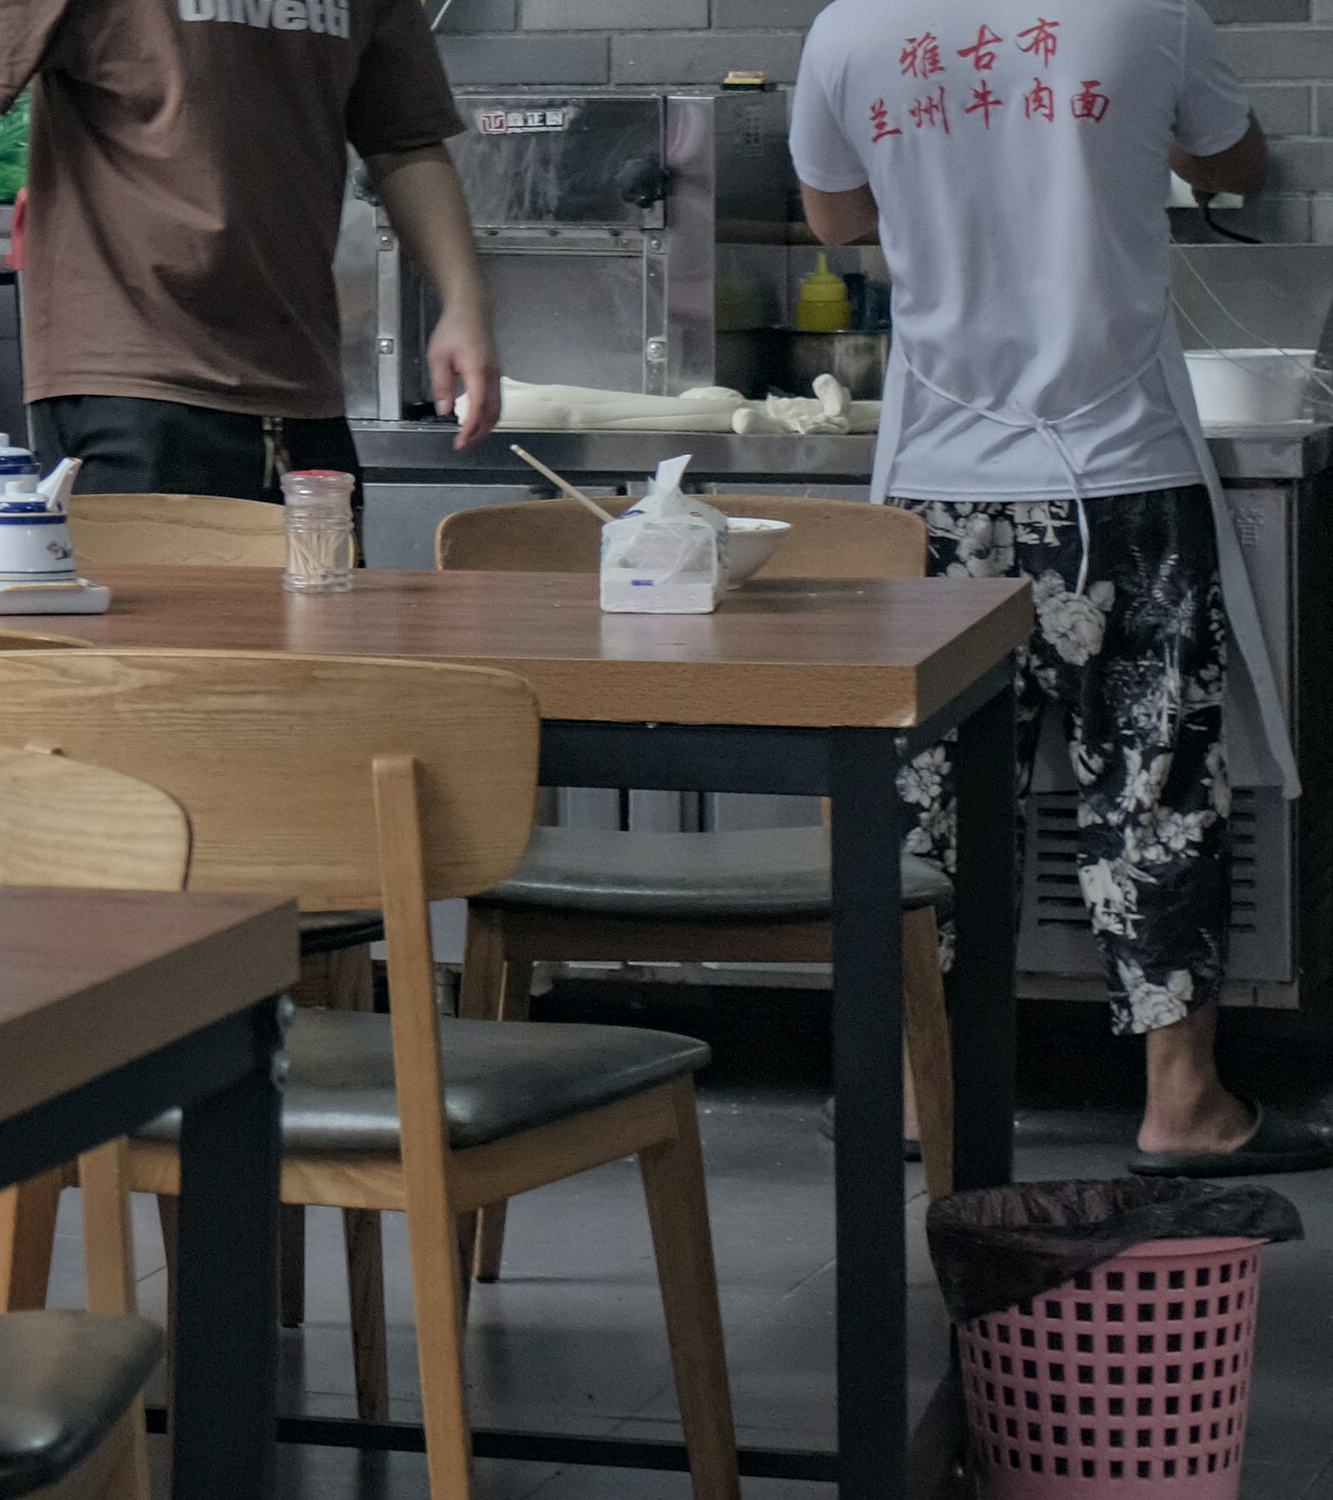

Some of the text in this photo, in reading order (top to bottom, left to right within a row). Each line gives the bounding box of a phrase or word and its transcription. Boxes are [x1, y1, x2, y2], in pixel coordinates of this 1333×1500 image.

[899, 17, 1060, 80] 雅古布
[869, 77, 1110, 143] 兰州牛肉面
